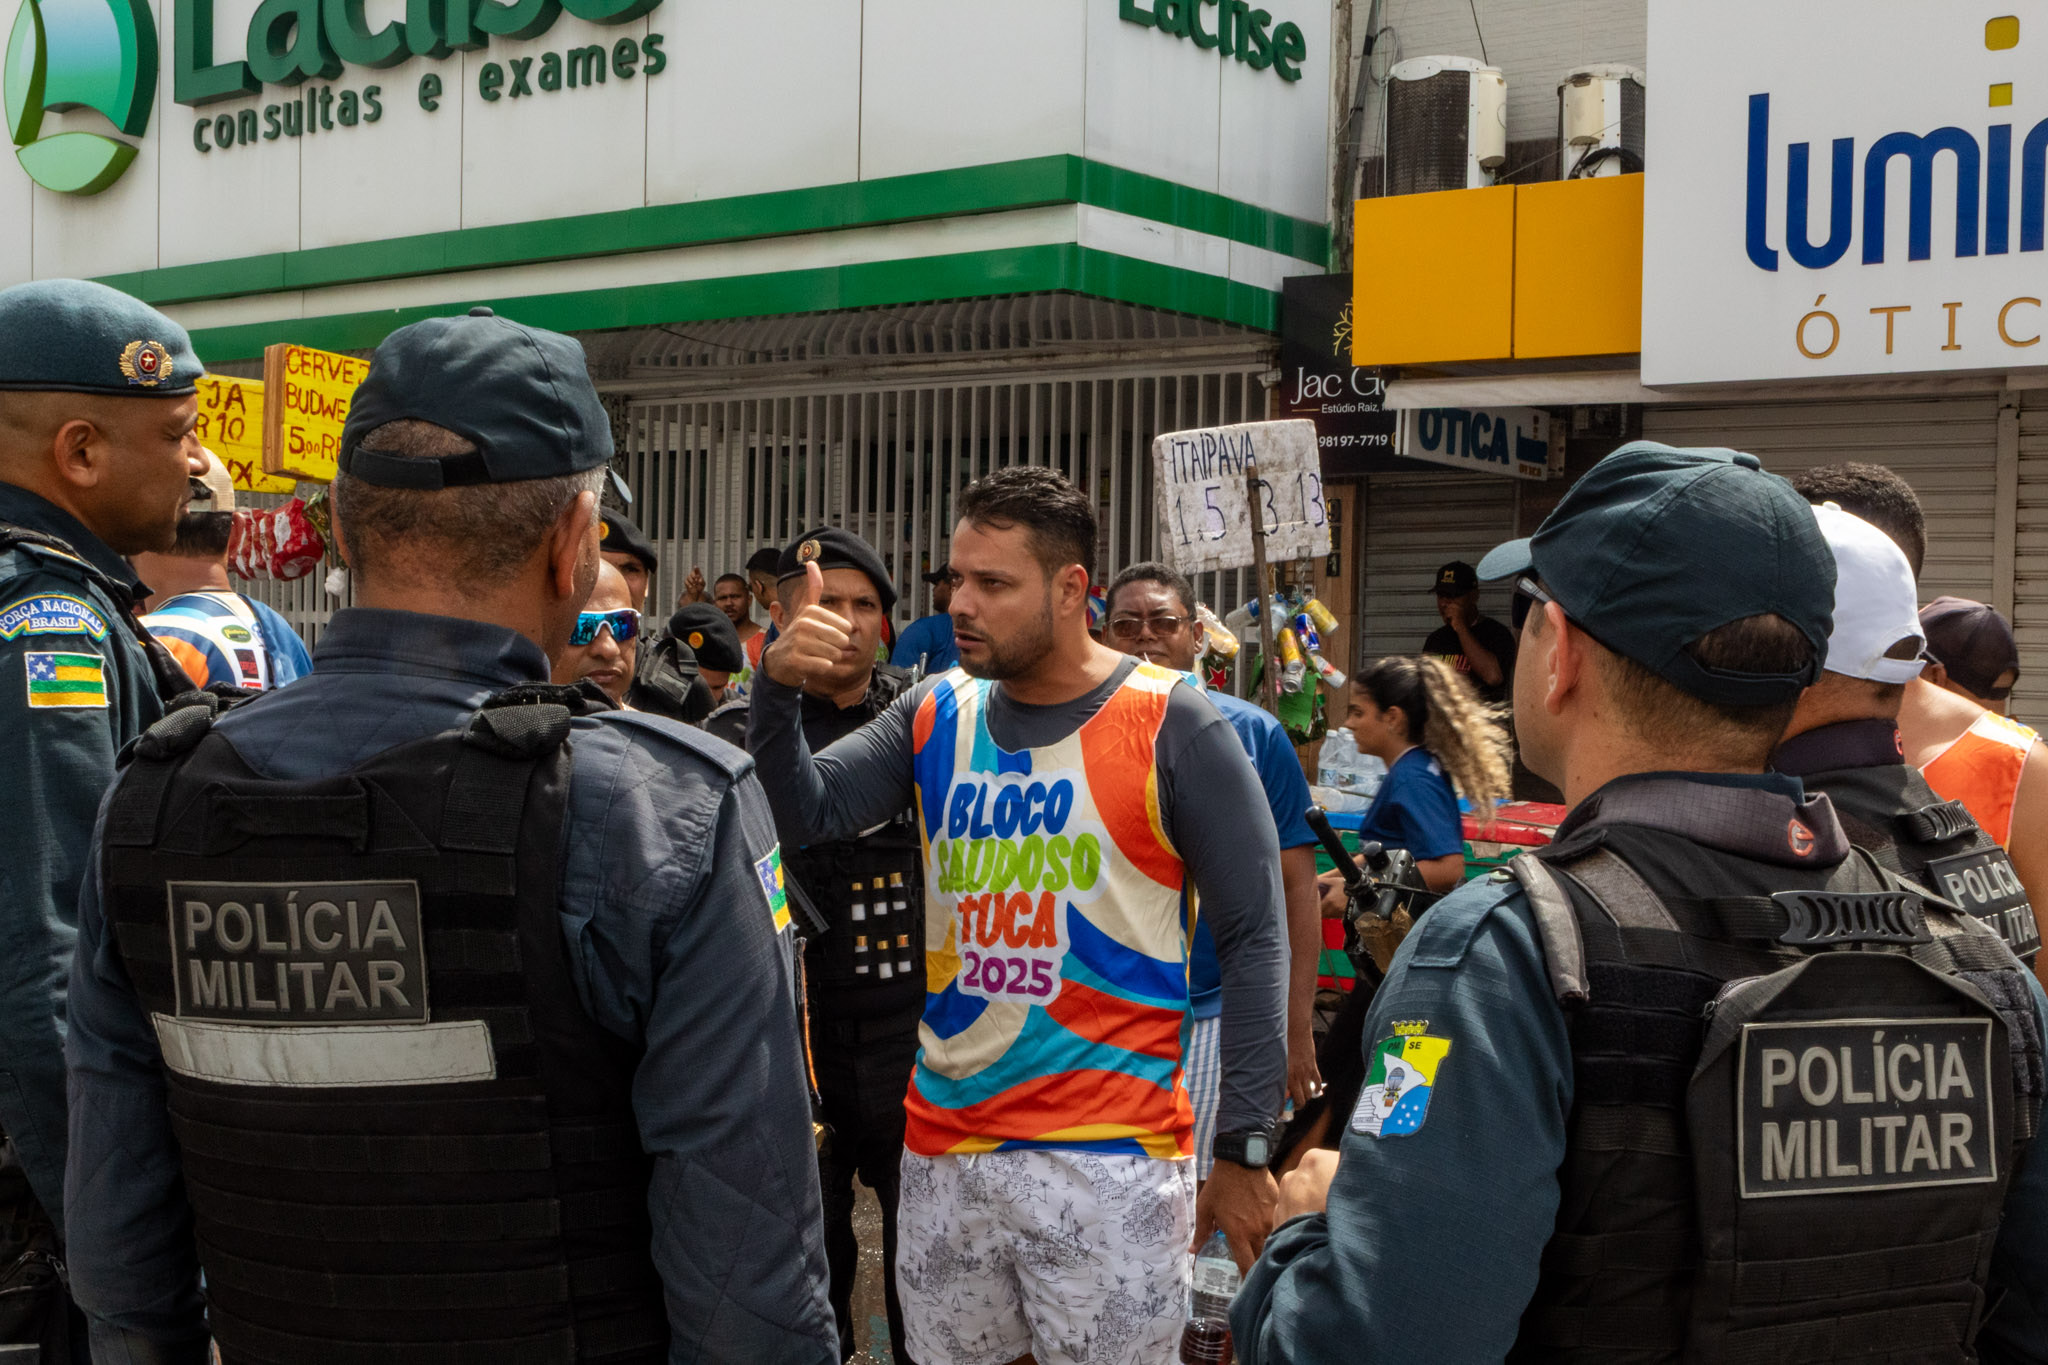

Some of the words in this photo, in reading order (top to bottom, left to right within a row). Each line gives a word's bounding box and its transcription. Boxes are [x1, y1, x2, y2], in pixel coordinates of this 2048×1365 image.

[194, 84, 383, 153] consultas
[418, 71, 442, 112] e
[478, 32, 667, 102] exames
[1796, 294, 2041, 359] ÓTIC
[1290, 367, 1342, 405] Jac
[1321, 403, 1356, 414] Estúdio
[1319, 434, 1388, 447] 98197-7719
[0, 603, 40, 631] FORÇA
[41, 600, 102, 631] NACIONAL
[31, 617, 80, 629] BRASIL
[948, 779, 1074, 840] BLOCO
[938, 833, 1101, 893] SAUDOSO
[186, 891, 407, 951] POLÍCIA
[957, 891, 1058, 949] TUCA
[189, 959, 411, 1012] MILITAR
[963, 951, 1054, 997] 2025
[1408, 1042, 1422, 1050] SE
[1761, 1030, 1975, 1108] POLÍCIA
[1761, 1113, 1976, 1182] MILITAR
